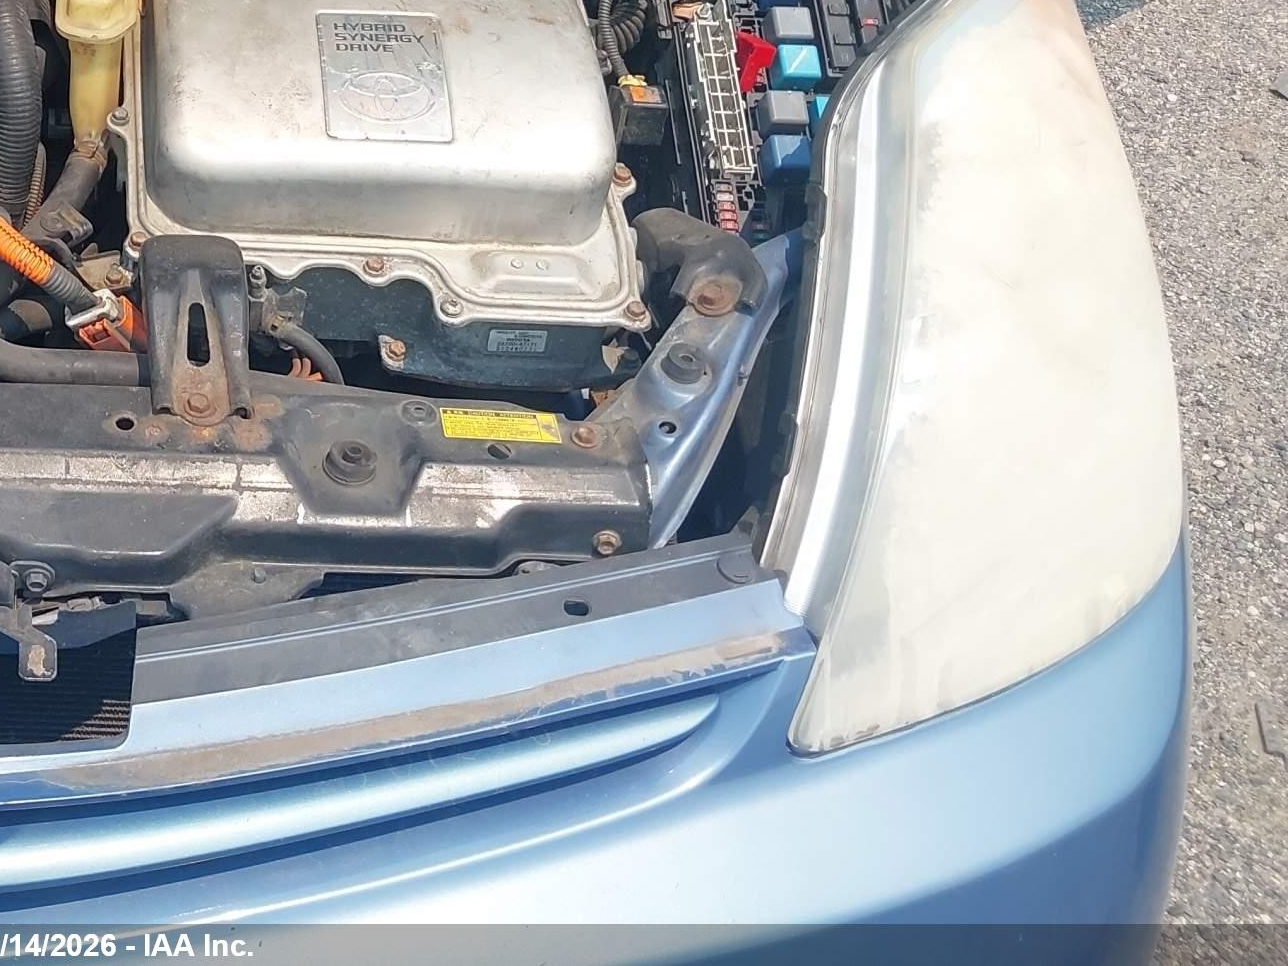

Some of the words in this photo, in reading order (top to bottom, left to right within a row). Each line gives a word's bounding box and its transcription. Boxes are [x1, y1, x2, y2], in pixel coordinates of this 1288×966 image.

[333, 23, 406, 33] HYBRID
[334, 33, 425, 43] SYNERGY
[335, 44, 394, 53] DRIVE
